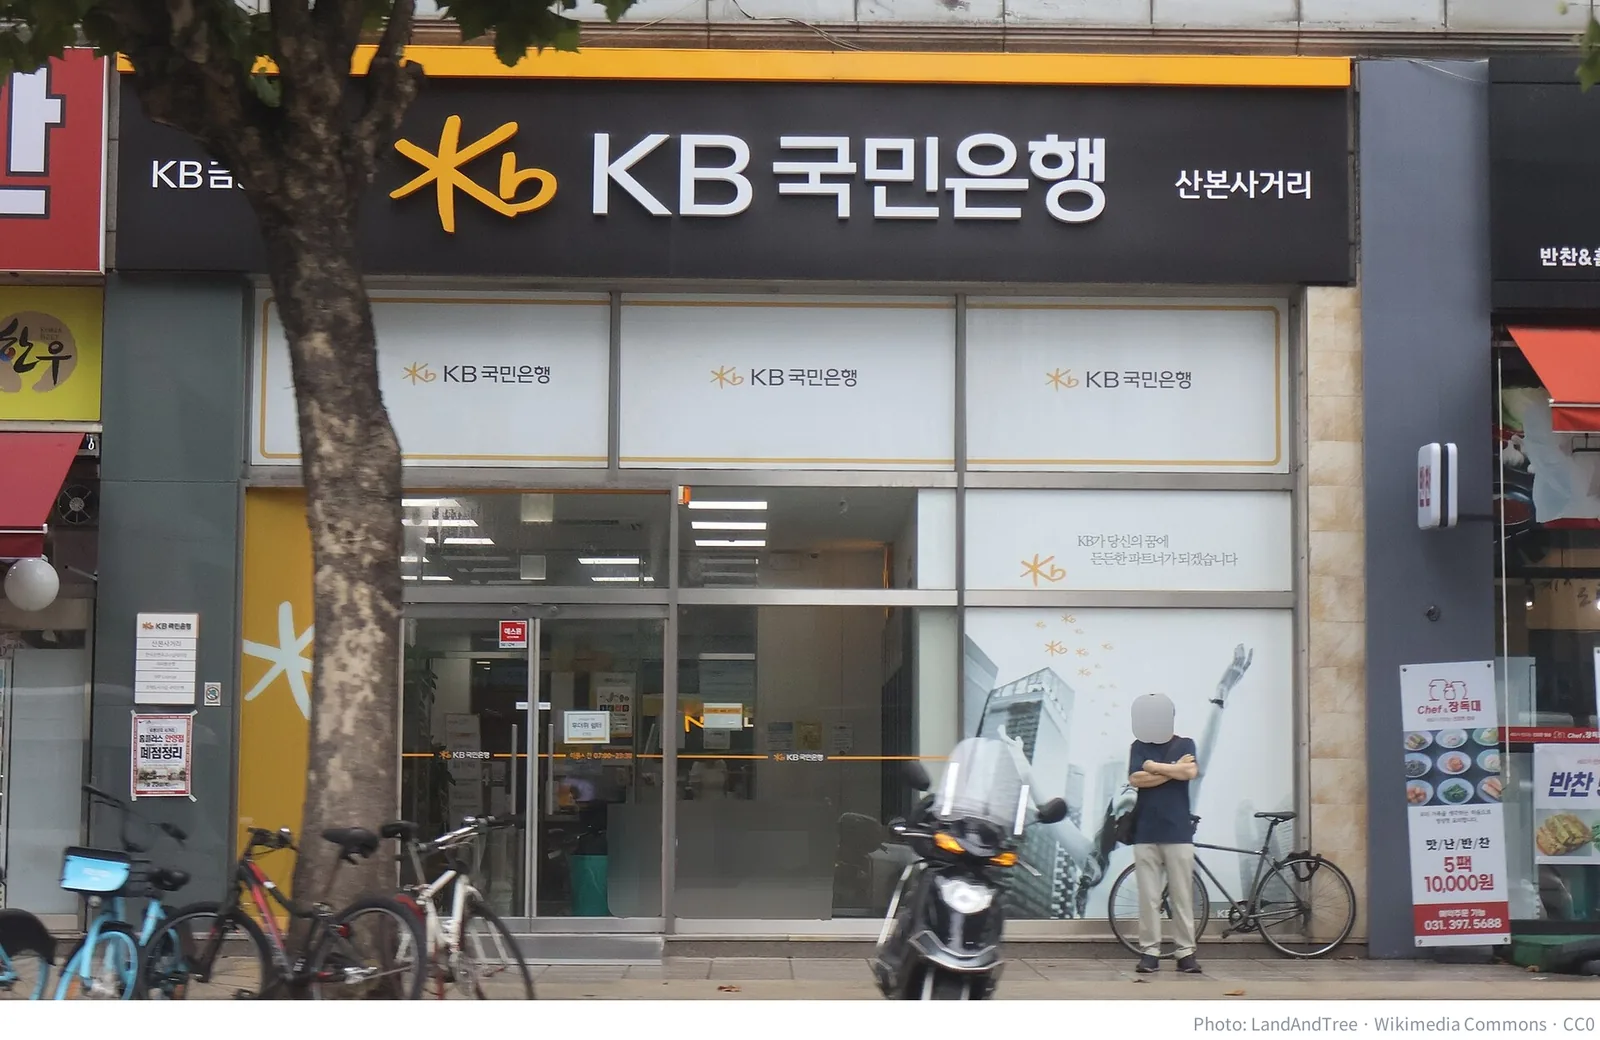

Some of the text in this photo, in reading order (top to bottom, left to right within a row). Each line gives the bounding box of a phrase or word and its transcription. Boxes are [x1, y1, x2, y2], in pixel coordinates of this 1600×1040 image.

[772, 132, 1106, 223] 국민은행
[1175, 170, 1312, 199] 산본사거리
[481, 365, 551, 384] 국민은행
[788, 368, 857, 388] 국민은행
[1123, 370, 1192, 390] 국민은행
[1077, 534, 1169, 549] KB가 당신의 꿈에
[1090, 552, 1239, 567] 든든한 파트너가 되겠습니다
[1417, 705, 1443, 715] Chef
[1448, 700, 1482, 713] 장독대
[140, 746, 183, 760] 폐점정리
[1549, 771, 1594, 798] 반찬
[1424, 873, 1494, 894] 10,000원
